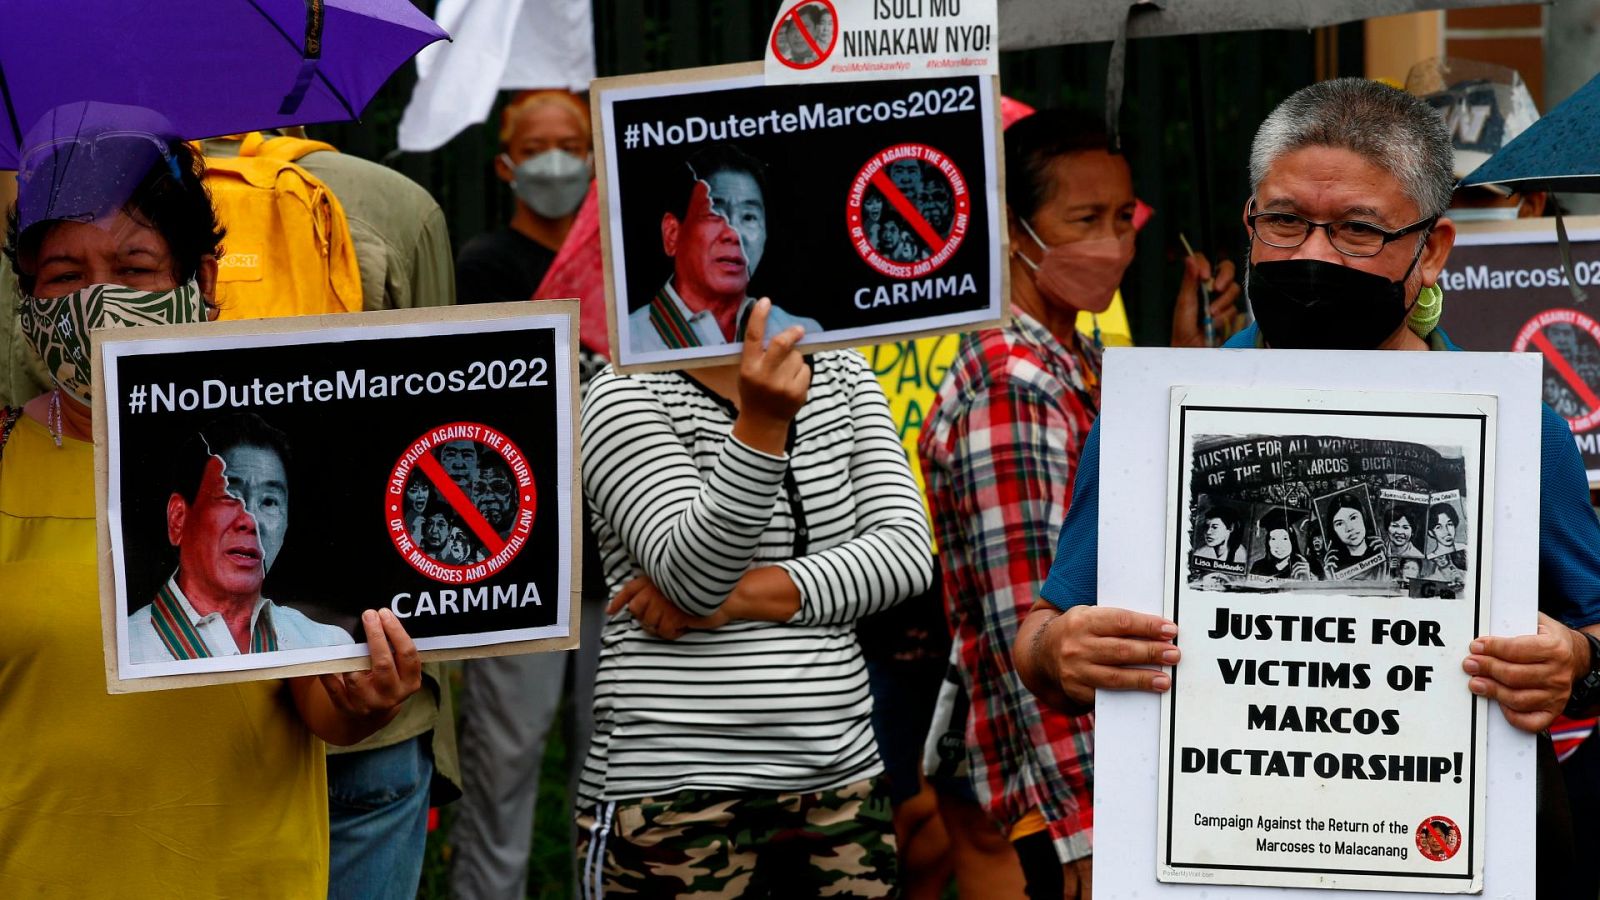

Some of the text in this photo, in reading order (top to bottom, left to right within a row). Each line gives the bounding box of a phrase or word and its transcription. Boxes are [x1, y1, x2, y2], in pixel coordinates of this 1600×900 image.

[843, 24, 991, 58] NINAKAW NYO!
[623, 85, 976, 150] #NoDuterteMarcos2022
[850, 146, 965, 207] CAMPAIGN AGAINST THE RETURN
[851, 213, 968, 277] OF THE MARCOSES AND MARTIAL LAW
[854, 273, 977, 310] CARMMA
[129, 357, 548, 415] #NoDuterteMarcos2022
[390, 425, 531, 495] CAMPAIGN AGAINST THE RETURN
[1257, 440, 1282, 457] FOR
[390, 508, 533, 582] OF THE MARCOSES AND MARTIAL LAW
[390, 582, 542, 620] CARMMA
[1207, 607, 1446, 647] JUSTICE FOR
[1217, 658, 1433, 692] VICTIMS OF
[1247, 704, 1400, 736] MARCOS
[1181, 747, 1464, 784] DICTATORSHIP!
[1194, 813, 1408, 834] Campaign Against the Return of the
[1256, 838, 1408, 860] Marcoses to Malacanang
